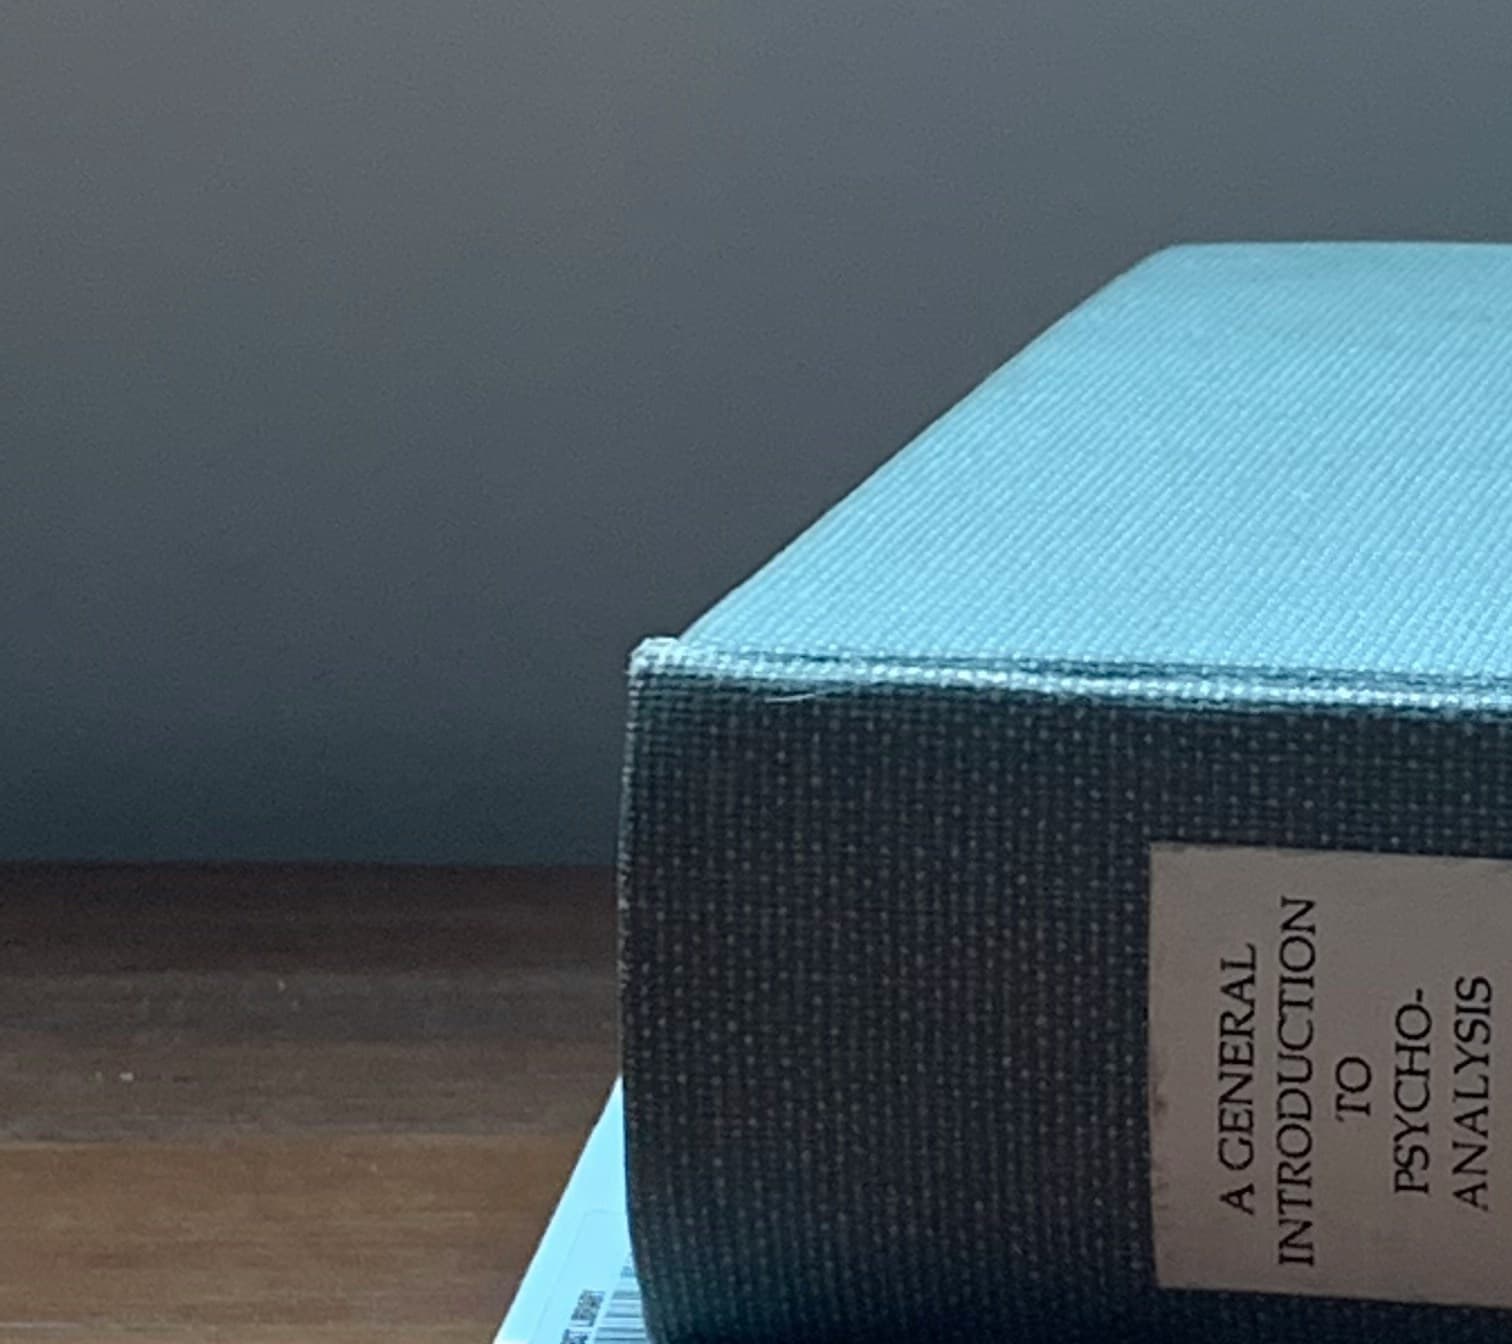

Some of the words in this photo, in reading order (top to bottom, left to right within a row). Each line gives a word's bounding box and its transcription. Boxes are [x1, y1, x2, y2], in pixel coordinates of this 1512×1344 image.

[1217, 943, 1257, 1171] GENERAL
[1276, 896, 1316, 1267] INTRODUCTION
[1335, 1056, 1372, 1122] TO
[1393, 988, 1433, 1194] PSYCHO-
[1452, 976, 1492, 1211] ANALYSIS
[1219, 1183, 1255, 1216] A
